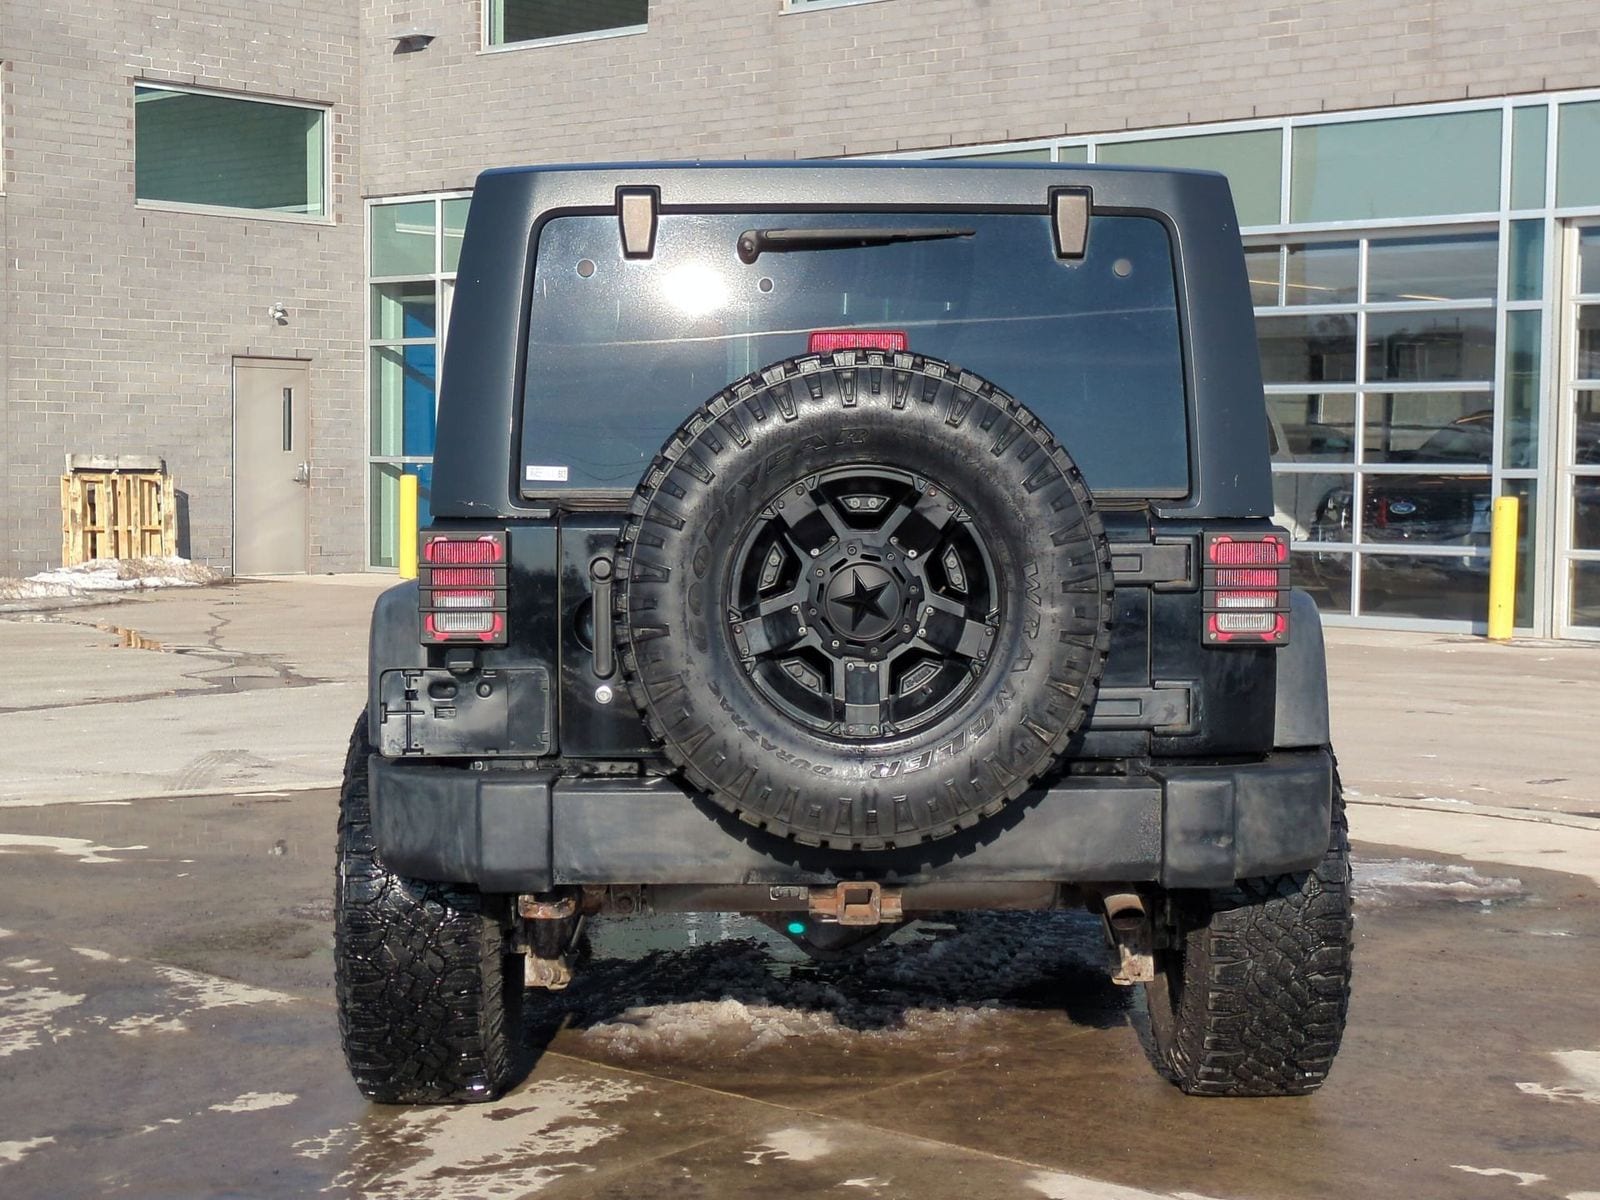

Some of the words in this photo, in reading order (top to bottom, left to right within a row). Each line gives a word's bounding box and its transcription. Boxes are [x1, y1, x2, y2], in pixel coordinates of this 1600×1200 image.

[687, 427, 868, 653] GOODYEAR
[705, 680, 833, 776] DURATRAC
[868, 561, 1042, 778] WRANGLER
